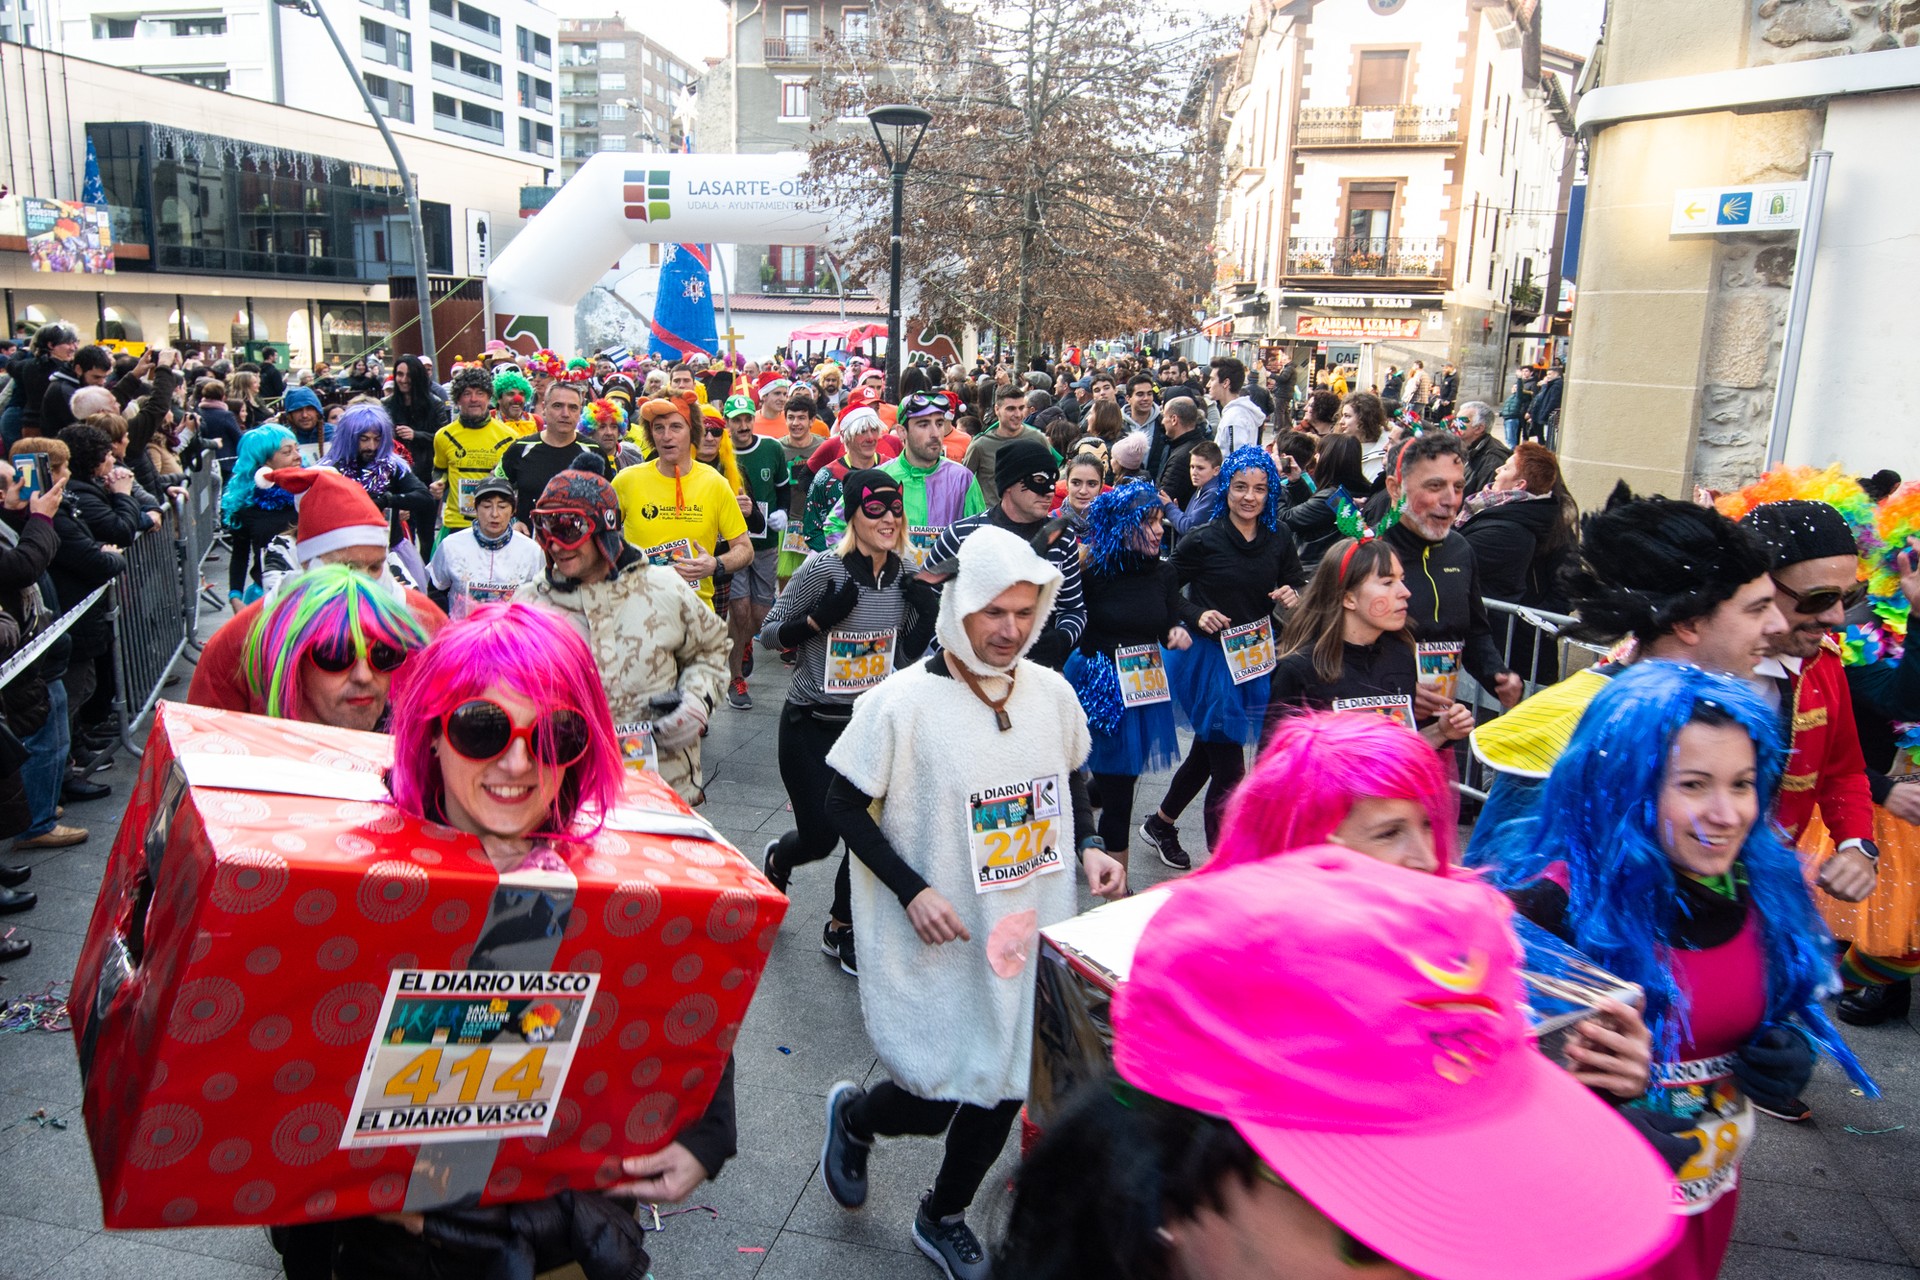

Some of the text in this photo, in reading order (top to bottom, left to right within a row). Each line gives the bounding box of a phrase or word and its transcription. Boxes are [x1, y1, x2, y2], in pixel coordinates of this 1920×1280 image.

[687, 201, 719, 210] UDALA
[1313, 296, 1413, 308] TABERNA KEBAB
[1318, 317, 1402, 332] TABERNA KEBAB
[1336, 352, 1361, 364] CAF
[645, 539, 688, 555] IARIO VASCO
[477, 582, 500, 590] DIARIO
[831, 628, 895, 640] EL DIARIO VASCO
[1231, 623, 1255, 634] DIARIO
[1428, 641, 1456, 651] DIARIO
[1234, 641, 1272, 669] 151
[834, 655, 885, 680] 338
[1234, 671, 1242, 679] EL
[1241, 664, 1262, 677] DIARIO
[838, 678, 866, 687] DIARIO
[1128, 669, 1165, 692] 150
[1337, 695, 1408, 709] EL DIARIO VASCO
[615, 721, 650, 735] VASCO
[970, 792, 983, 803] EL
[984, 783, 1026, 800] DIARIO
[984, 819, 1051, 867] 227
[979, 851, 1058, 883] EL DIARIO VASCO
[399, 973, 591, 992] EL DIARIO VASCO
[467, 1003, 489, 1013] SAN
[465, 1012, 511, 1023] SILVESTRE
[383, 1047, 549, 1106] 414
[357, 1102, 548, 1131] EL DIARIO VASCO
